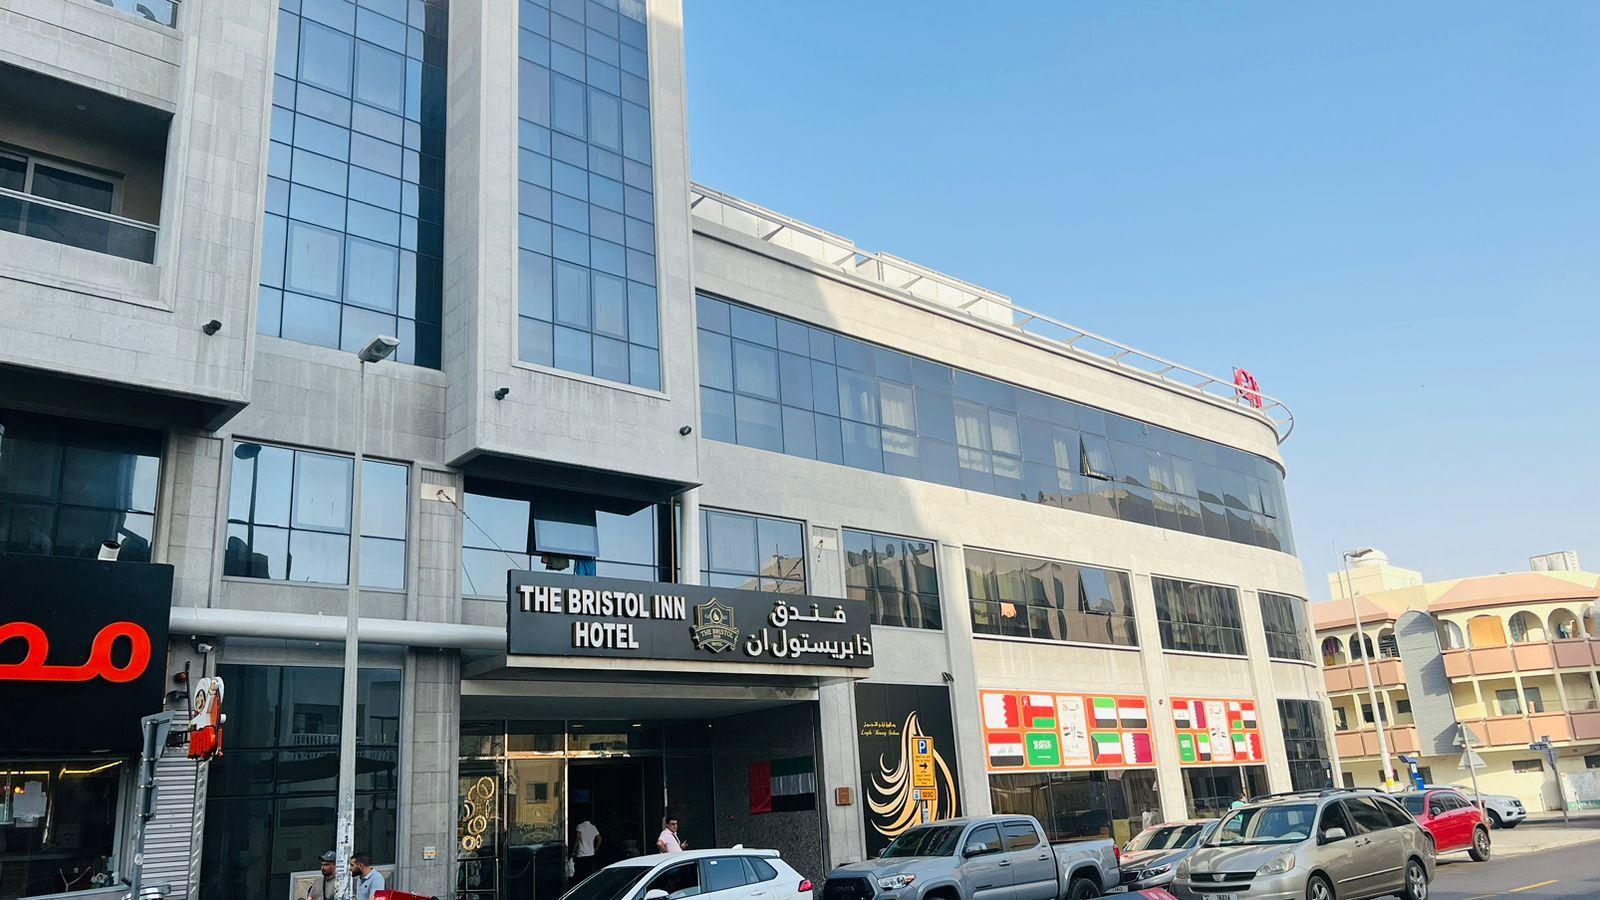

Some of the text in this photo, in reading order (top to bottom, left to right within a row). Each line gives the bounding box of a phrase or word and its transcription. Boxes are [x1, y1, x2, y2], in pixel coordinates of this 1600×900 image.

[518, 585, 687, 620] THE BRISTOL INN
[770, 600, 847, 627] فندق
[574, 621, 640, 649] HOTEL
[700, 628, 734, 639] THE BRISTOL
[771, 629, 854, 659] بريستول
[856, 633, 872, 655] ذا
